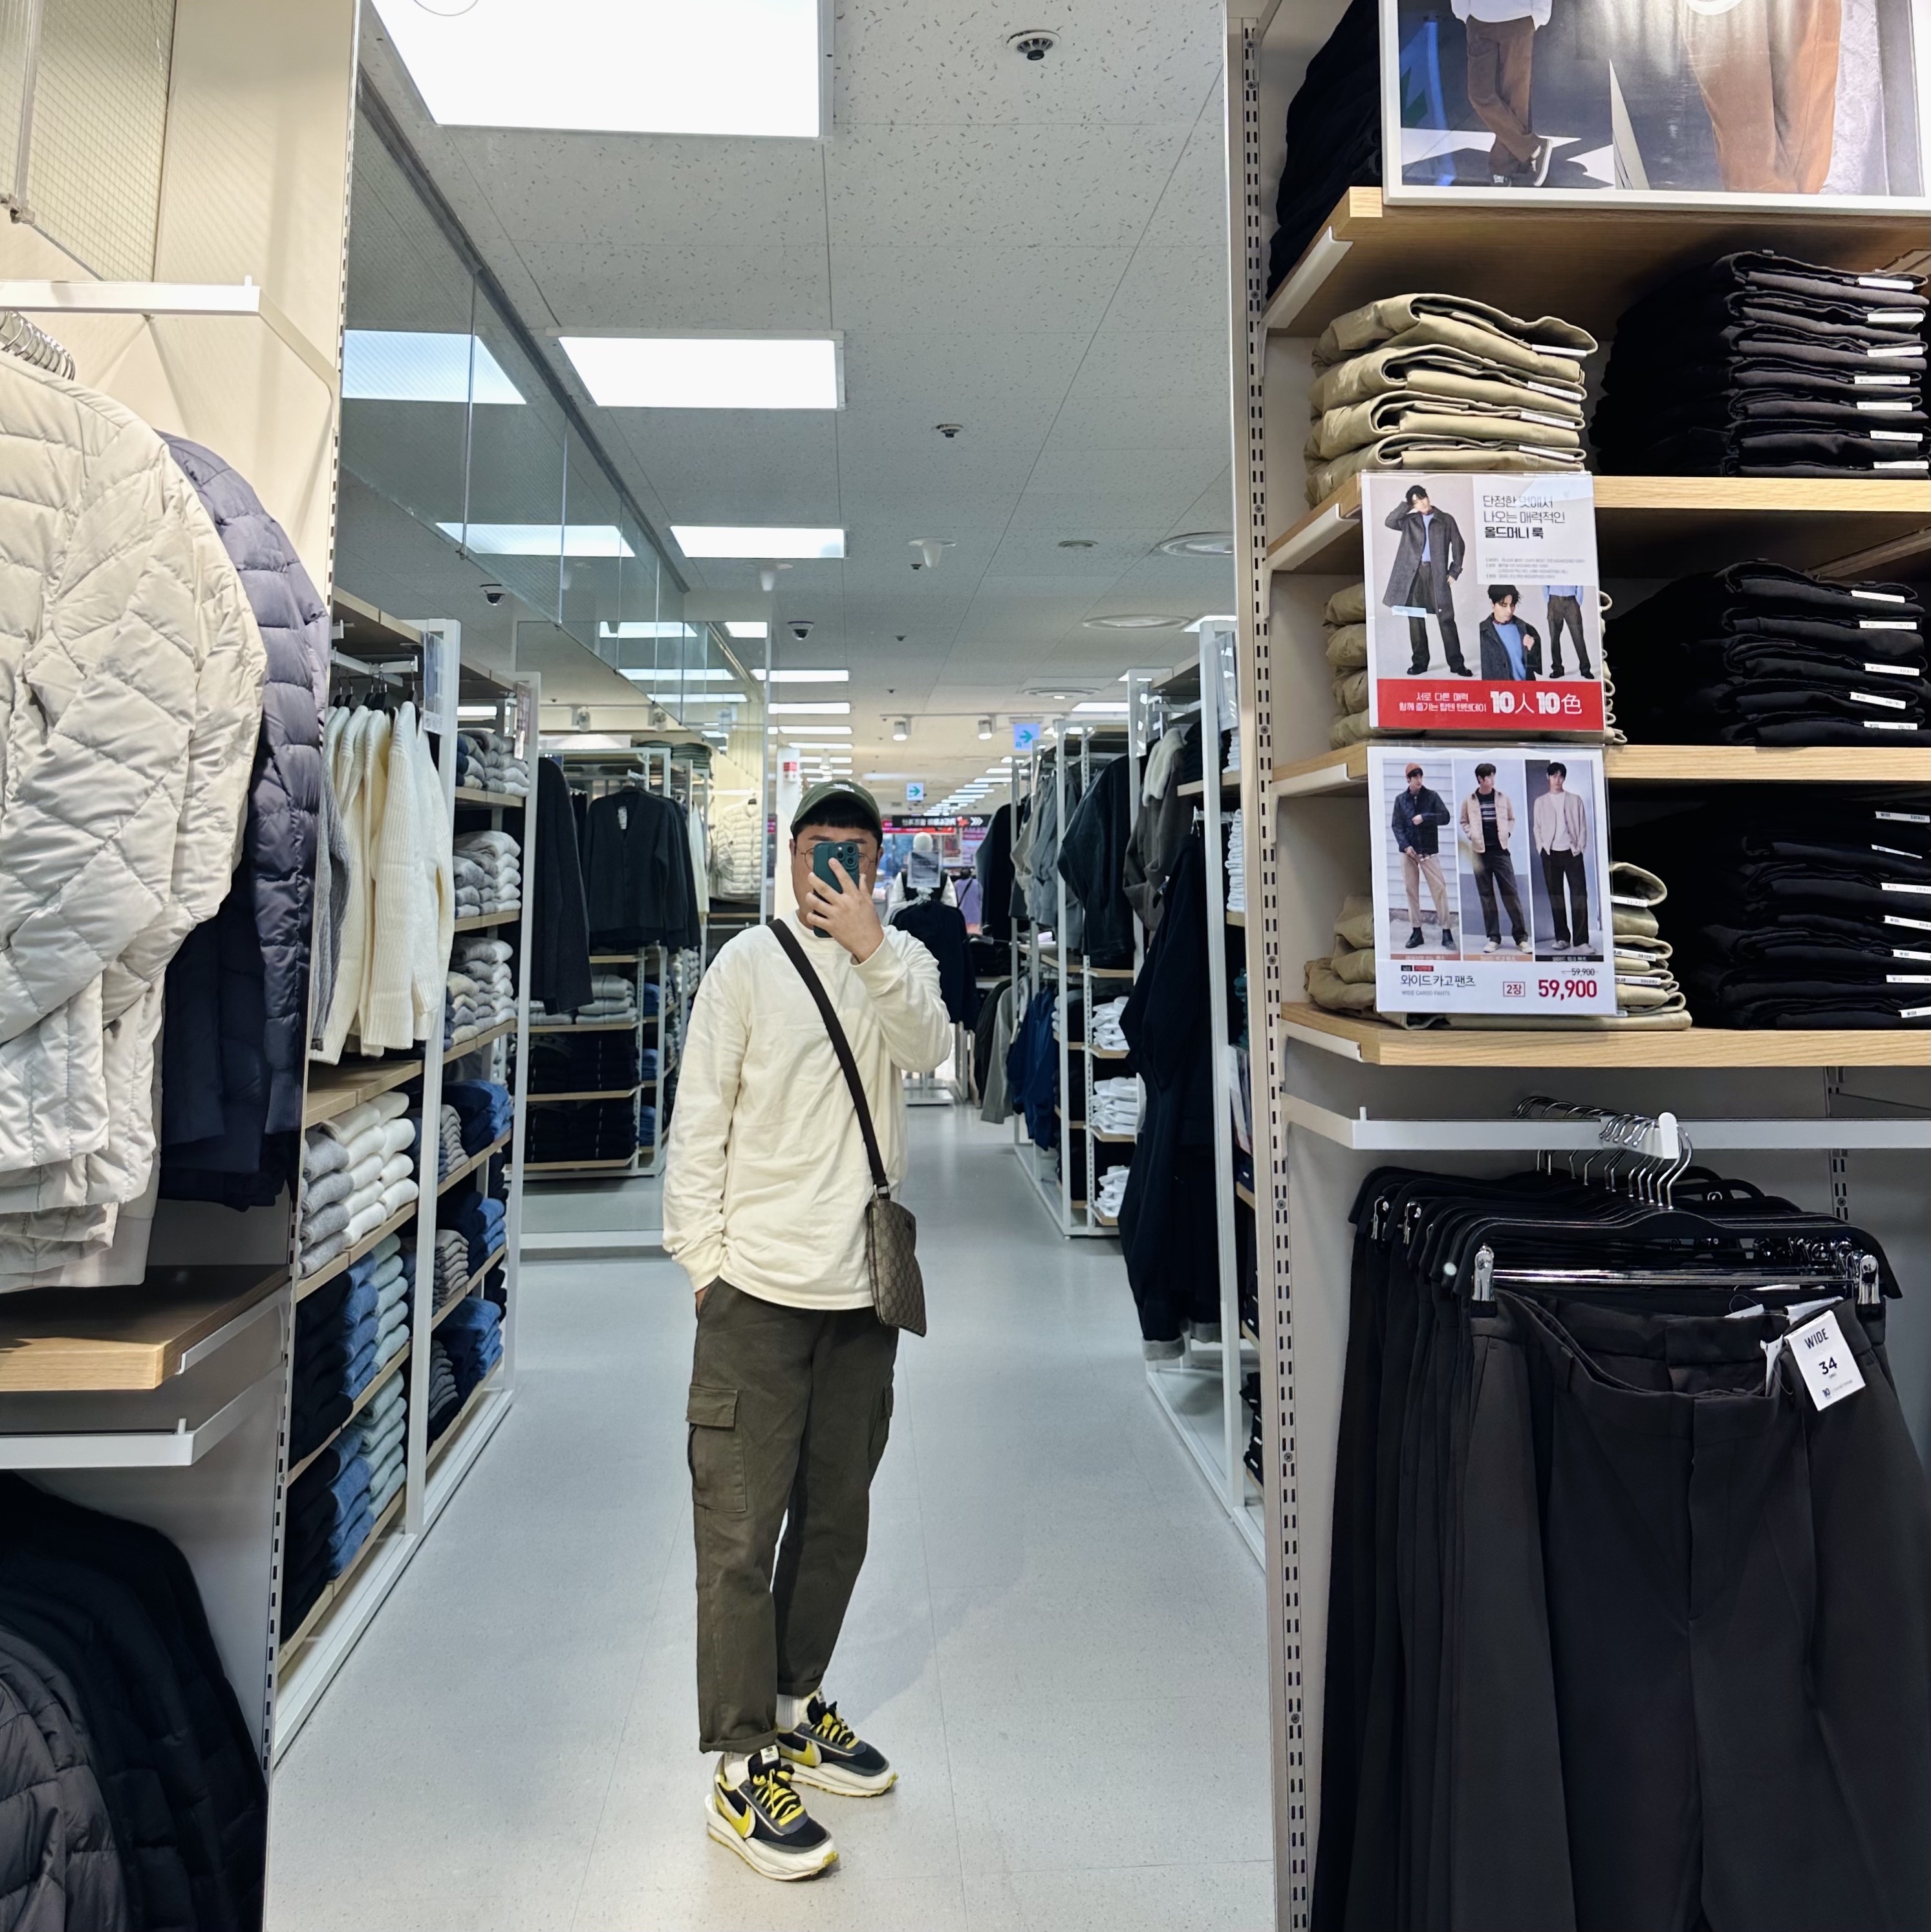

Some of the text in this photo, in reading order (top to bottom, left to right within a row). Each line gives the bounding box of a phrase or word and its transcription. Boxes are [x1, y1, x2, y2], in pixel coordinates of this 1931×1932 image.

[1483, 495, 1553, 508] 단정한 멋에서
[1483, 511, 1566, 524] 나오는 매력적인
[1484, 526, 1544, 539] 올드머니 룩
[1416, 692, 1469, 702] 서로 다른 매력
[1490, 691, 1582, 714] 10人10色
[1399, 702, 1487, 713] 함께 즐기는 탑텐 텐텐데이
[1571, 968, 1595, 977] 59,900
[1401, 974, 1476, 987] 와이드 카고 팬츠
[1506, 984, 1522, 995] 2장
[1538, 980, 1597, 1001] 59,900
[1804, 1328, 1829, 1349] WIDE
[1818, 1356, 1838, 1375] 34
